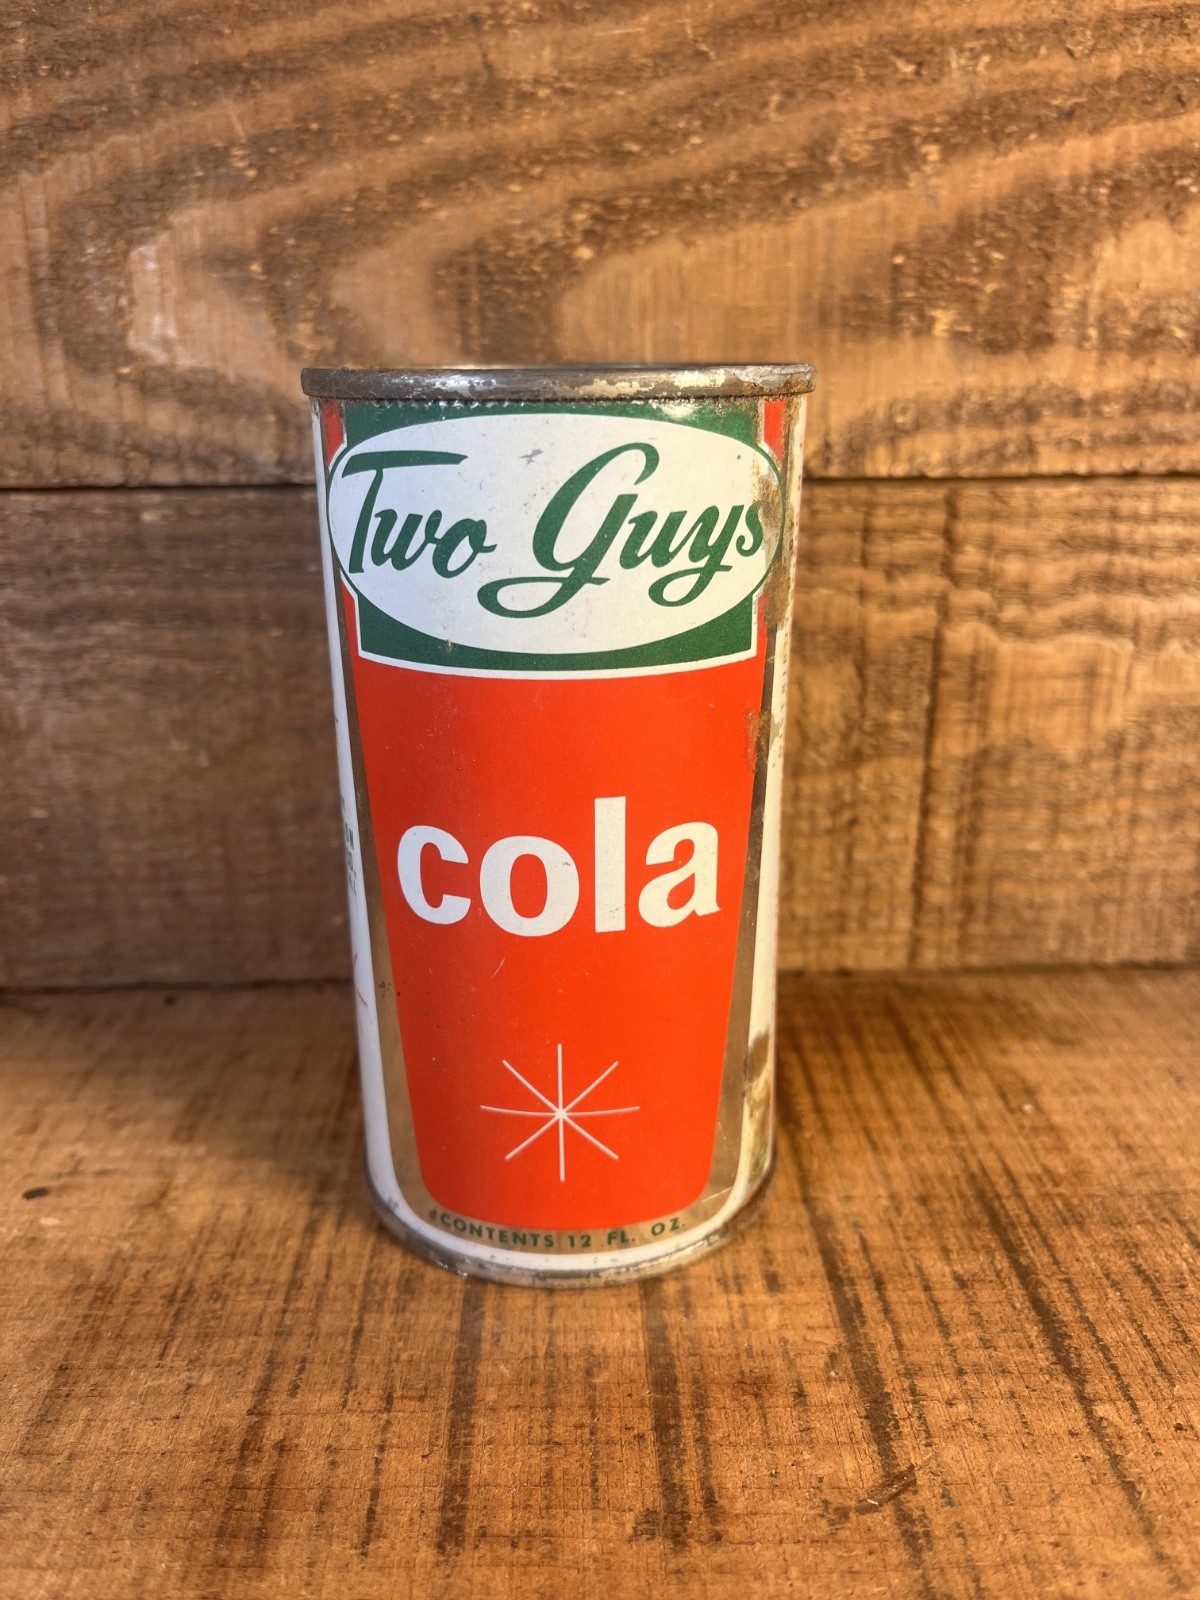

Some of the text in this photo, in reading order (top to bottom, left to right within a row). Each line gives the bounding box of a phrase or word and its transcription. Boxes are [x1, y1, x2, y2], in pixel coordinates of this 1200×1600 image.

[341, 442, 764, 619] Two Guys
[397, 796, 721, 937] cola
[440, 1212, 686, 1248] CONTENTS 12 FL. OZ.
